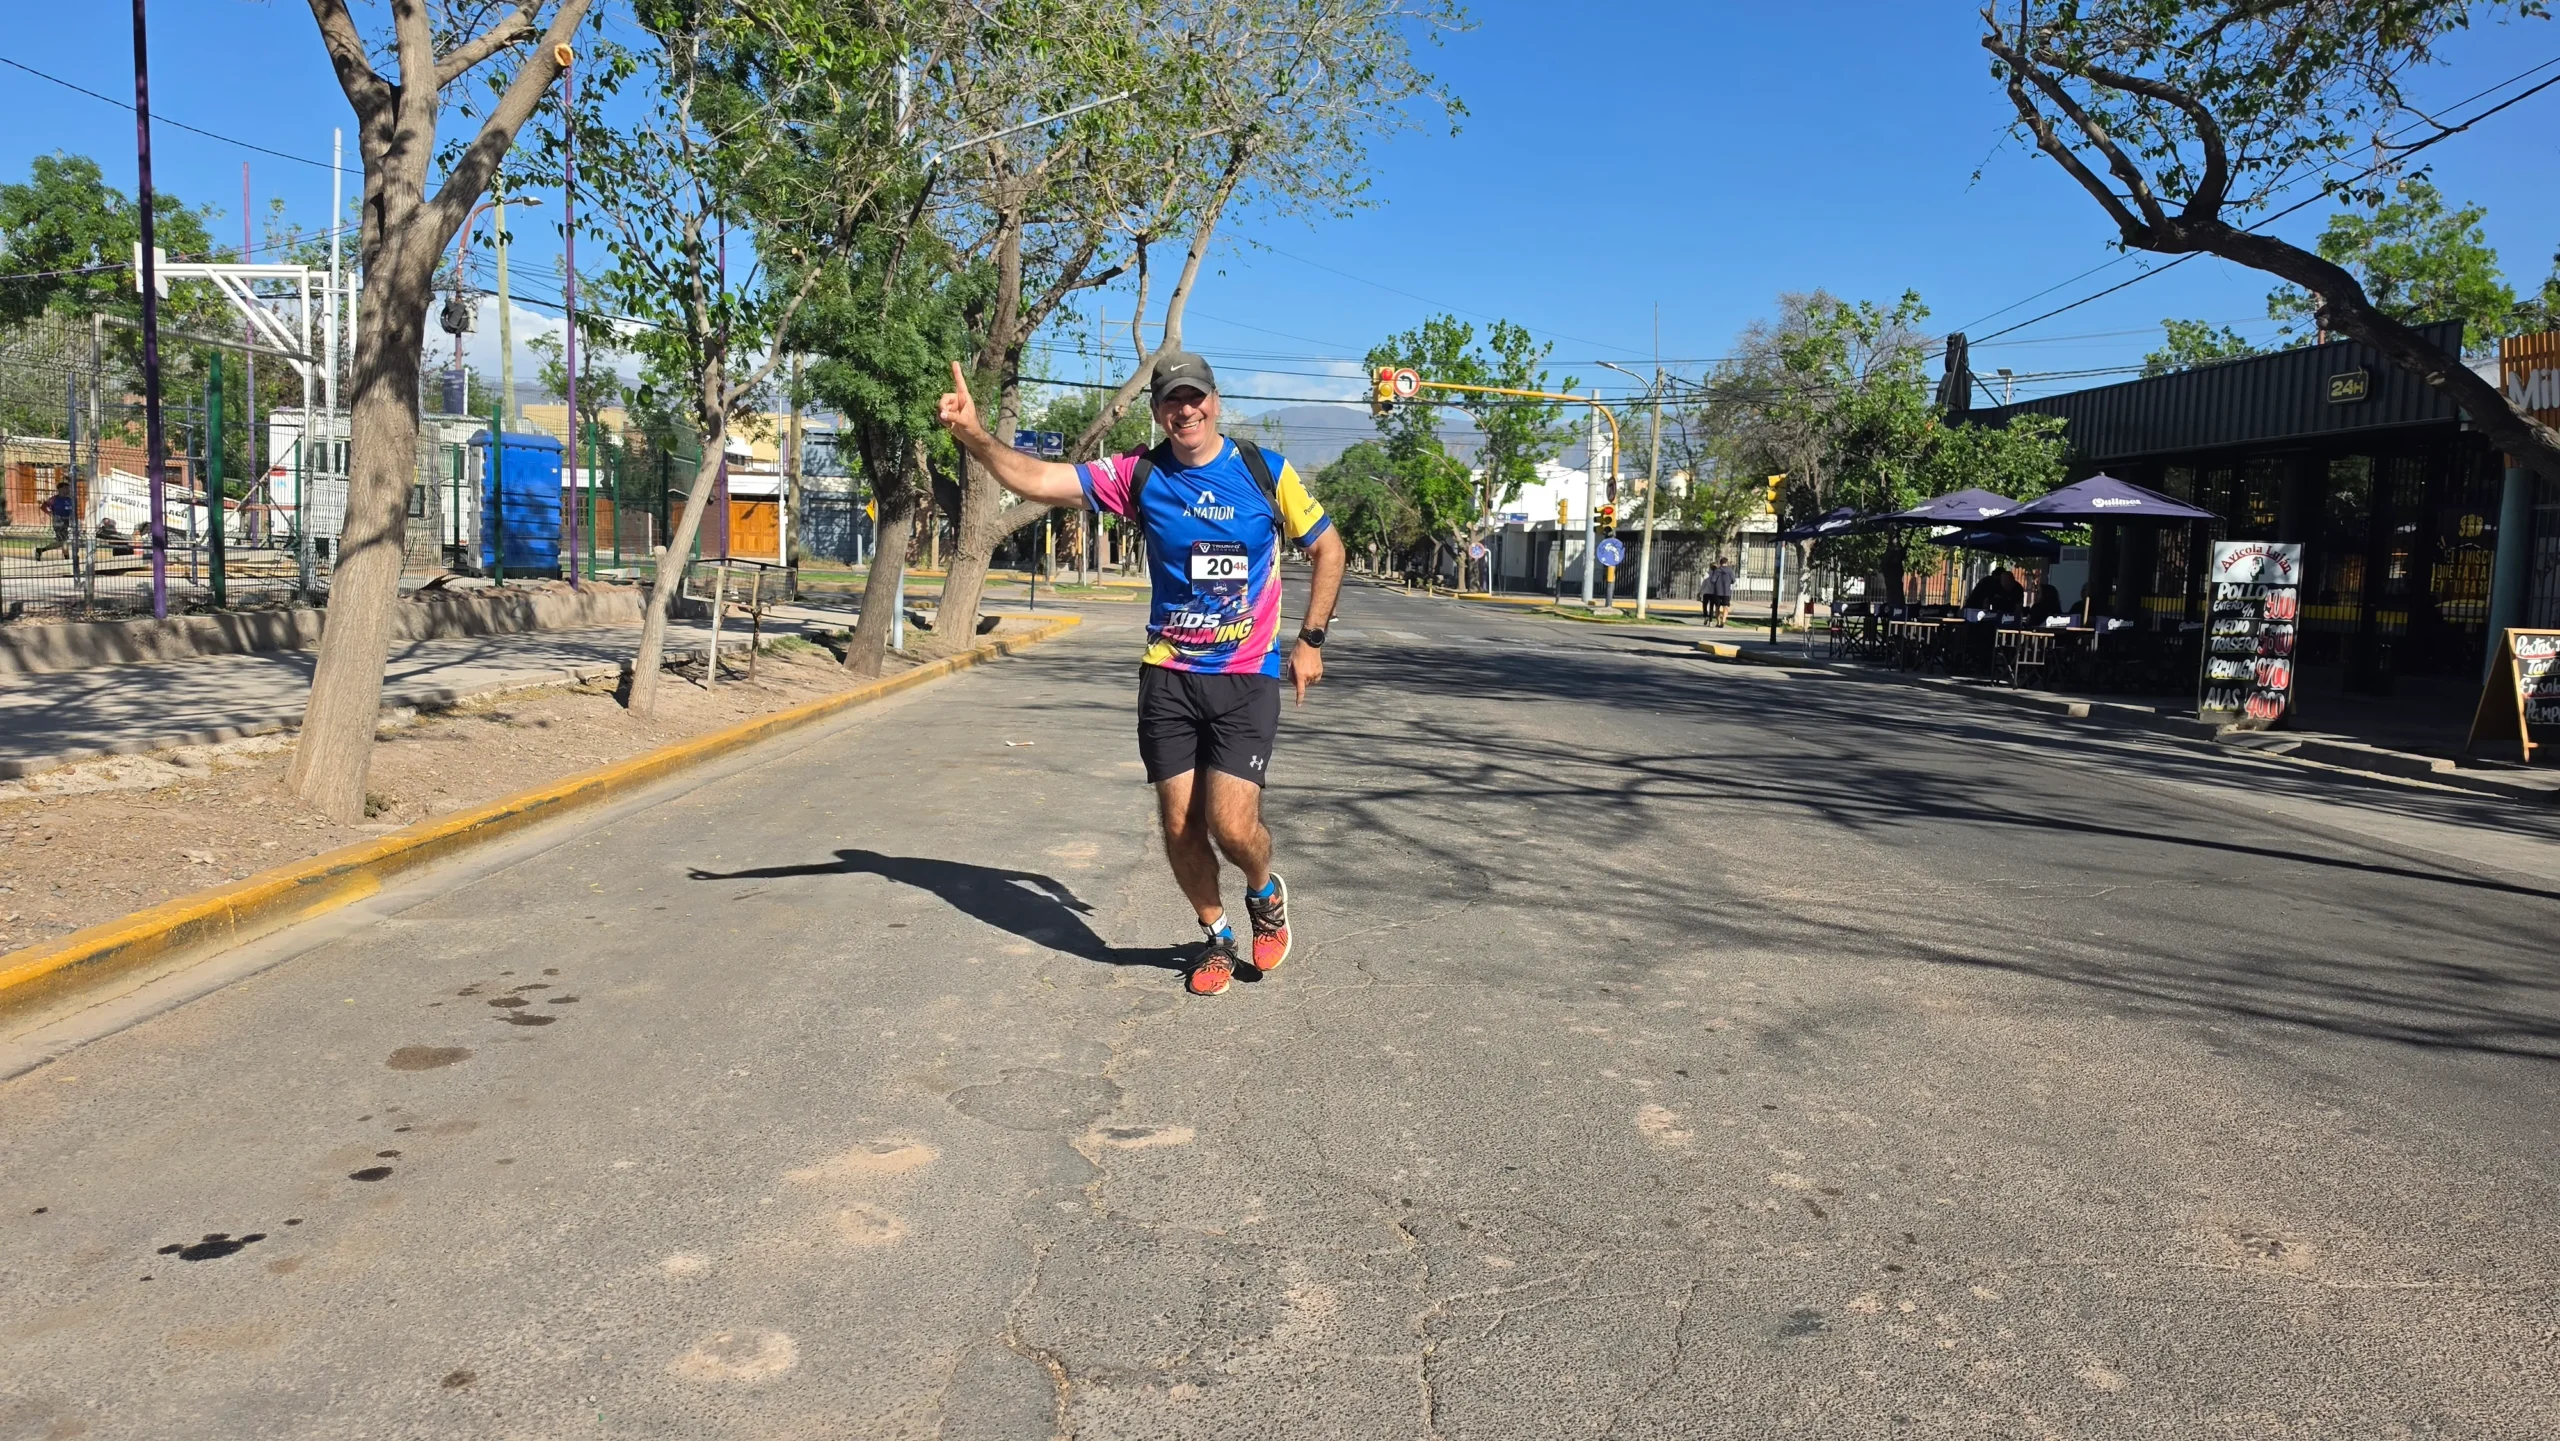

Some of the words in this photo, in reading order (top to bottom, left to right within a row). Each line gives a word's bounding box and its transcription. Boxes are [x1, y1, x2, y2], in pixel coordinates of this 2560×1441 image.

[2331, 379, 2364, 396] 24H
[2092, 498, 2142, 508] Quilmes
[1193, 505, 1235, 520] NATION
[1207, 558, 1234, 576] 20
[1234, 562, 1248, 571] 4k
[2221, 543, 2264, 573] Avícola
[2265, 545, 2292, 575] Luján
[2217, 582, 2269, 601] POLLO
[2213, 600, 2244, 612] ENTERO
[1168, 611, 1222, 628] KIDS
[2212, 619, 2250, 635] MEDIO
[1161, 618, 1254, 644] RUNNING
[2211, 635, 2259, 652] TRASERO
[2516, 635, 2555, 657] Pastas
[2205, 656, 2256, 680] PECHUGA
[2202, 687, 2240, 711] ALAS
[2244, 690, 2286, 720] 4000
